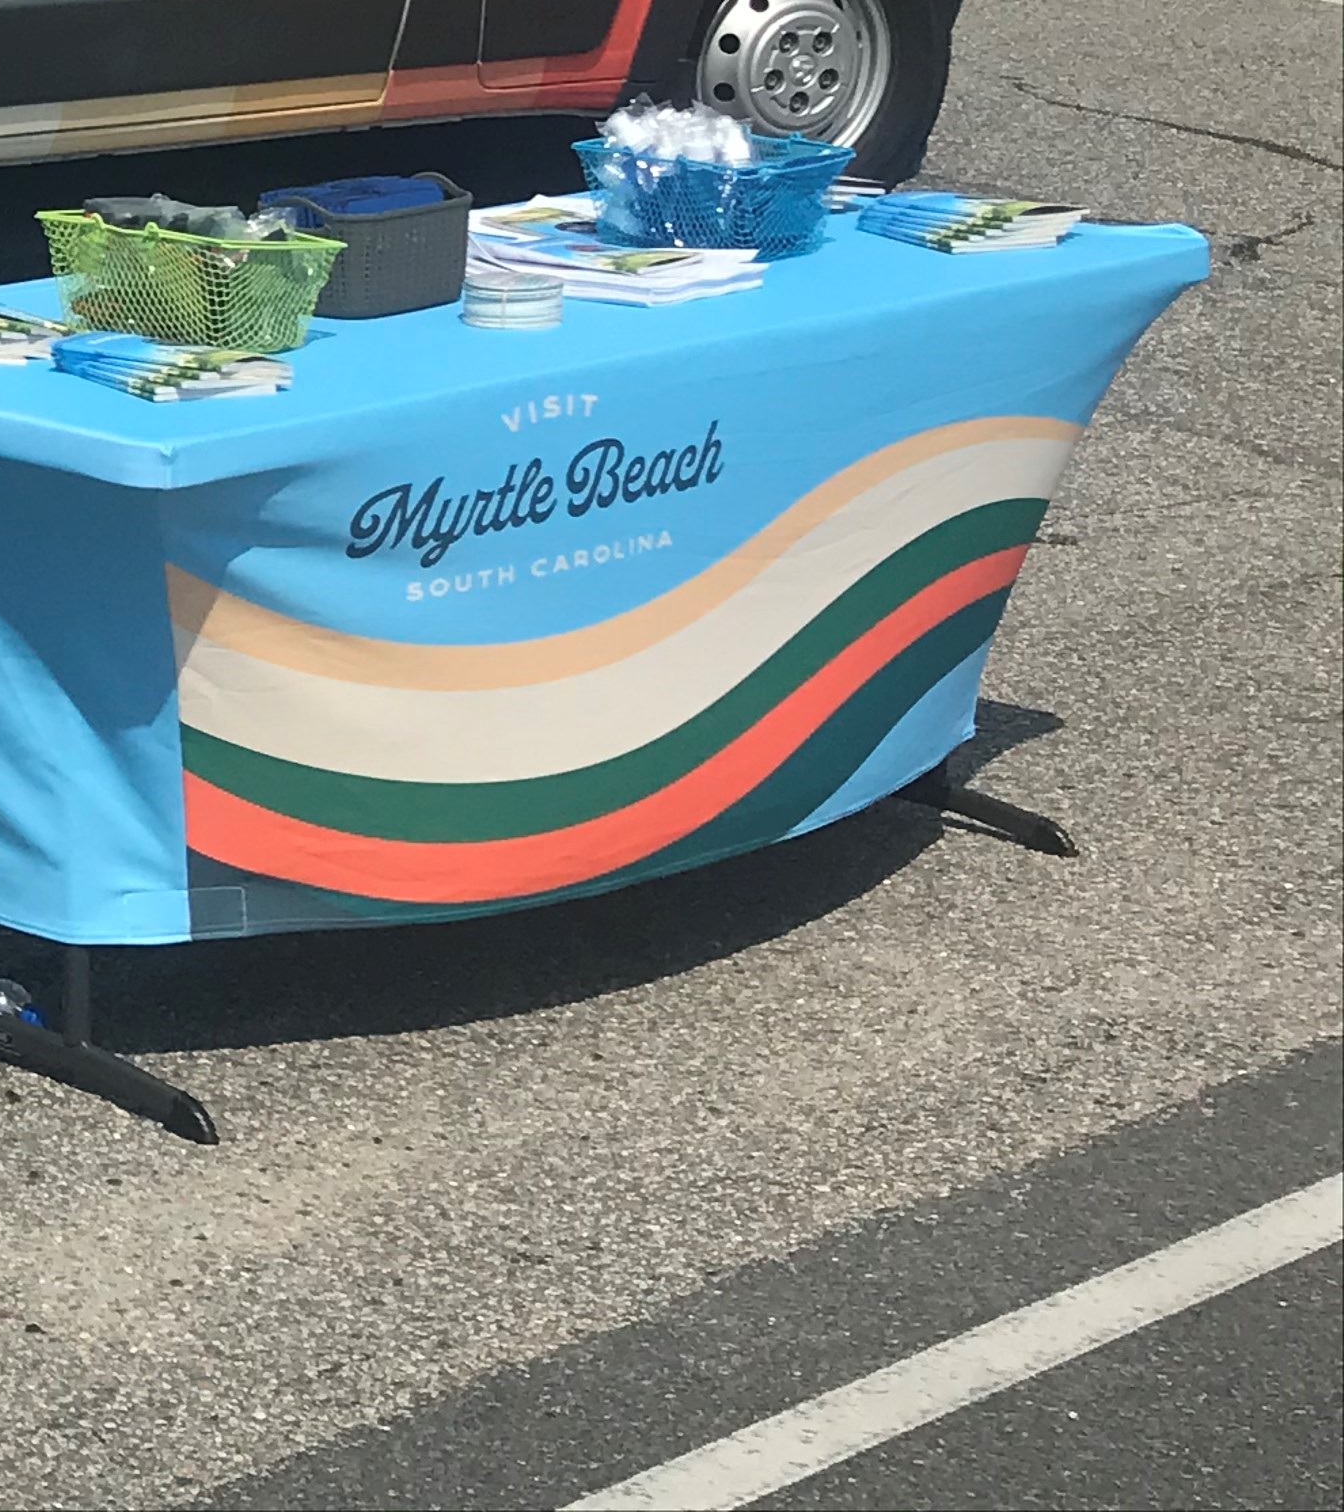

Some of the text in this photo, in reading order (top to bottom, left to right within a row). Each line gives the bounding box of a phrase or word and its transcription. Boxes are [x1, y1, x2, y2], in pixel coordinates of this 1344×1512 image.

[500, 393, 599, 433] VISIT
[345, 419, 725, 569] Myrtle Beach
[405, 530, 674, 602] SOUTH CAROLINA
